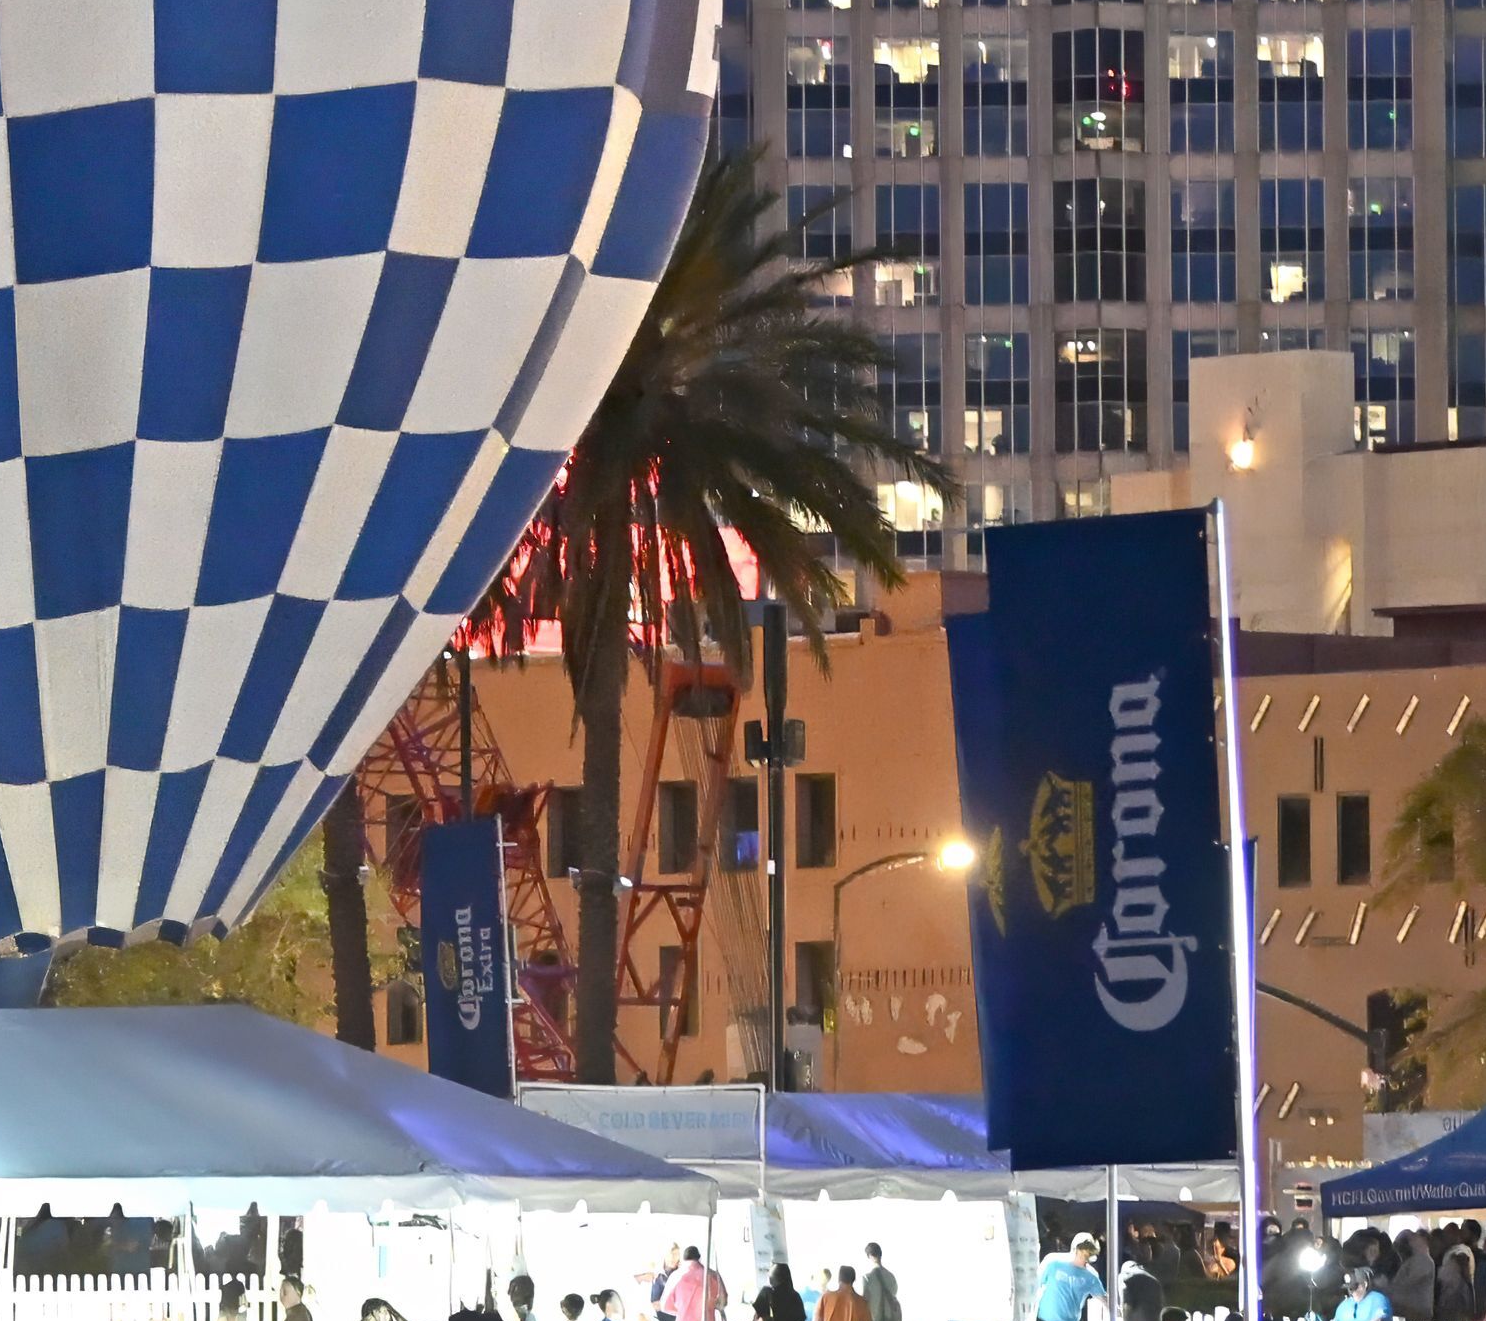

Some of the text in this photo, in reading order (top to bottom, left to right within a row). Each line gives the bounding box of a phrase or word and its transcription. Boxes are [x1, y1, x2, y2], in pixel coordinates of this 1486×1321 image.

[1093, 668, 1198, 1031] Corona
[455, 906, 482, 1030] Corona
[476, 927, 493, 994] Extra
